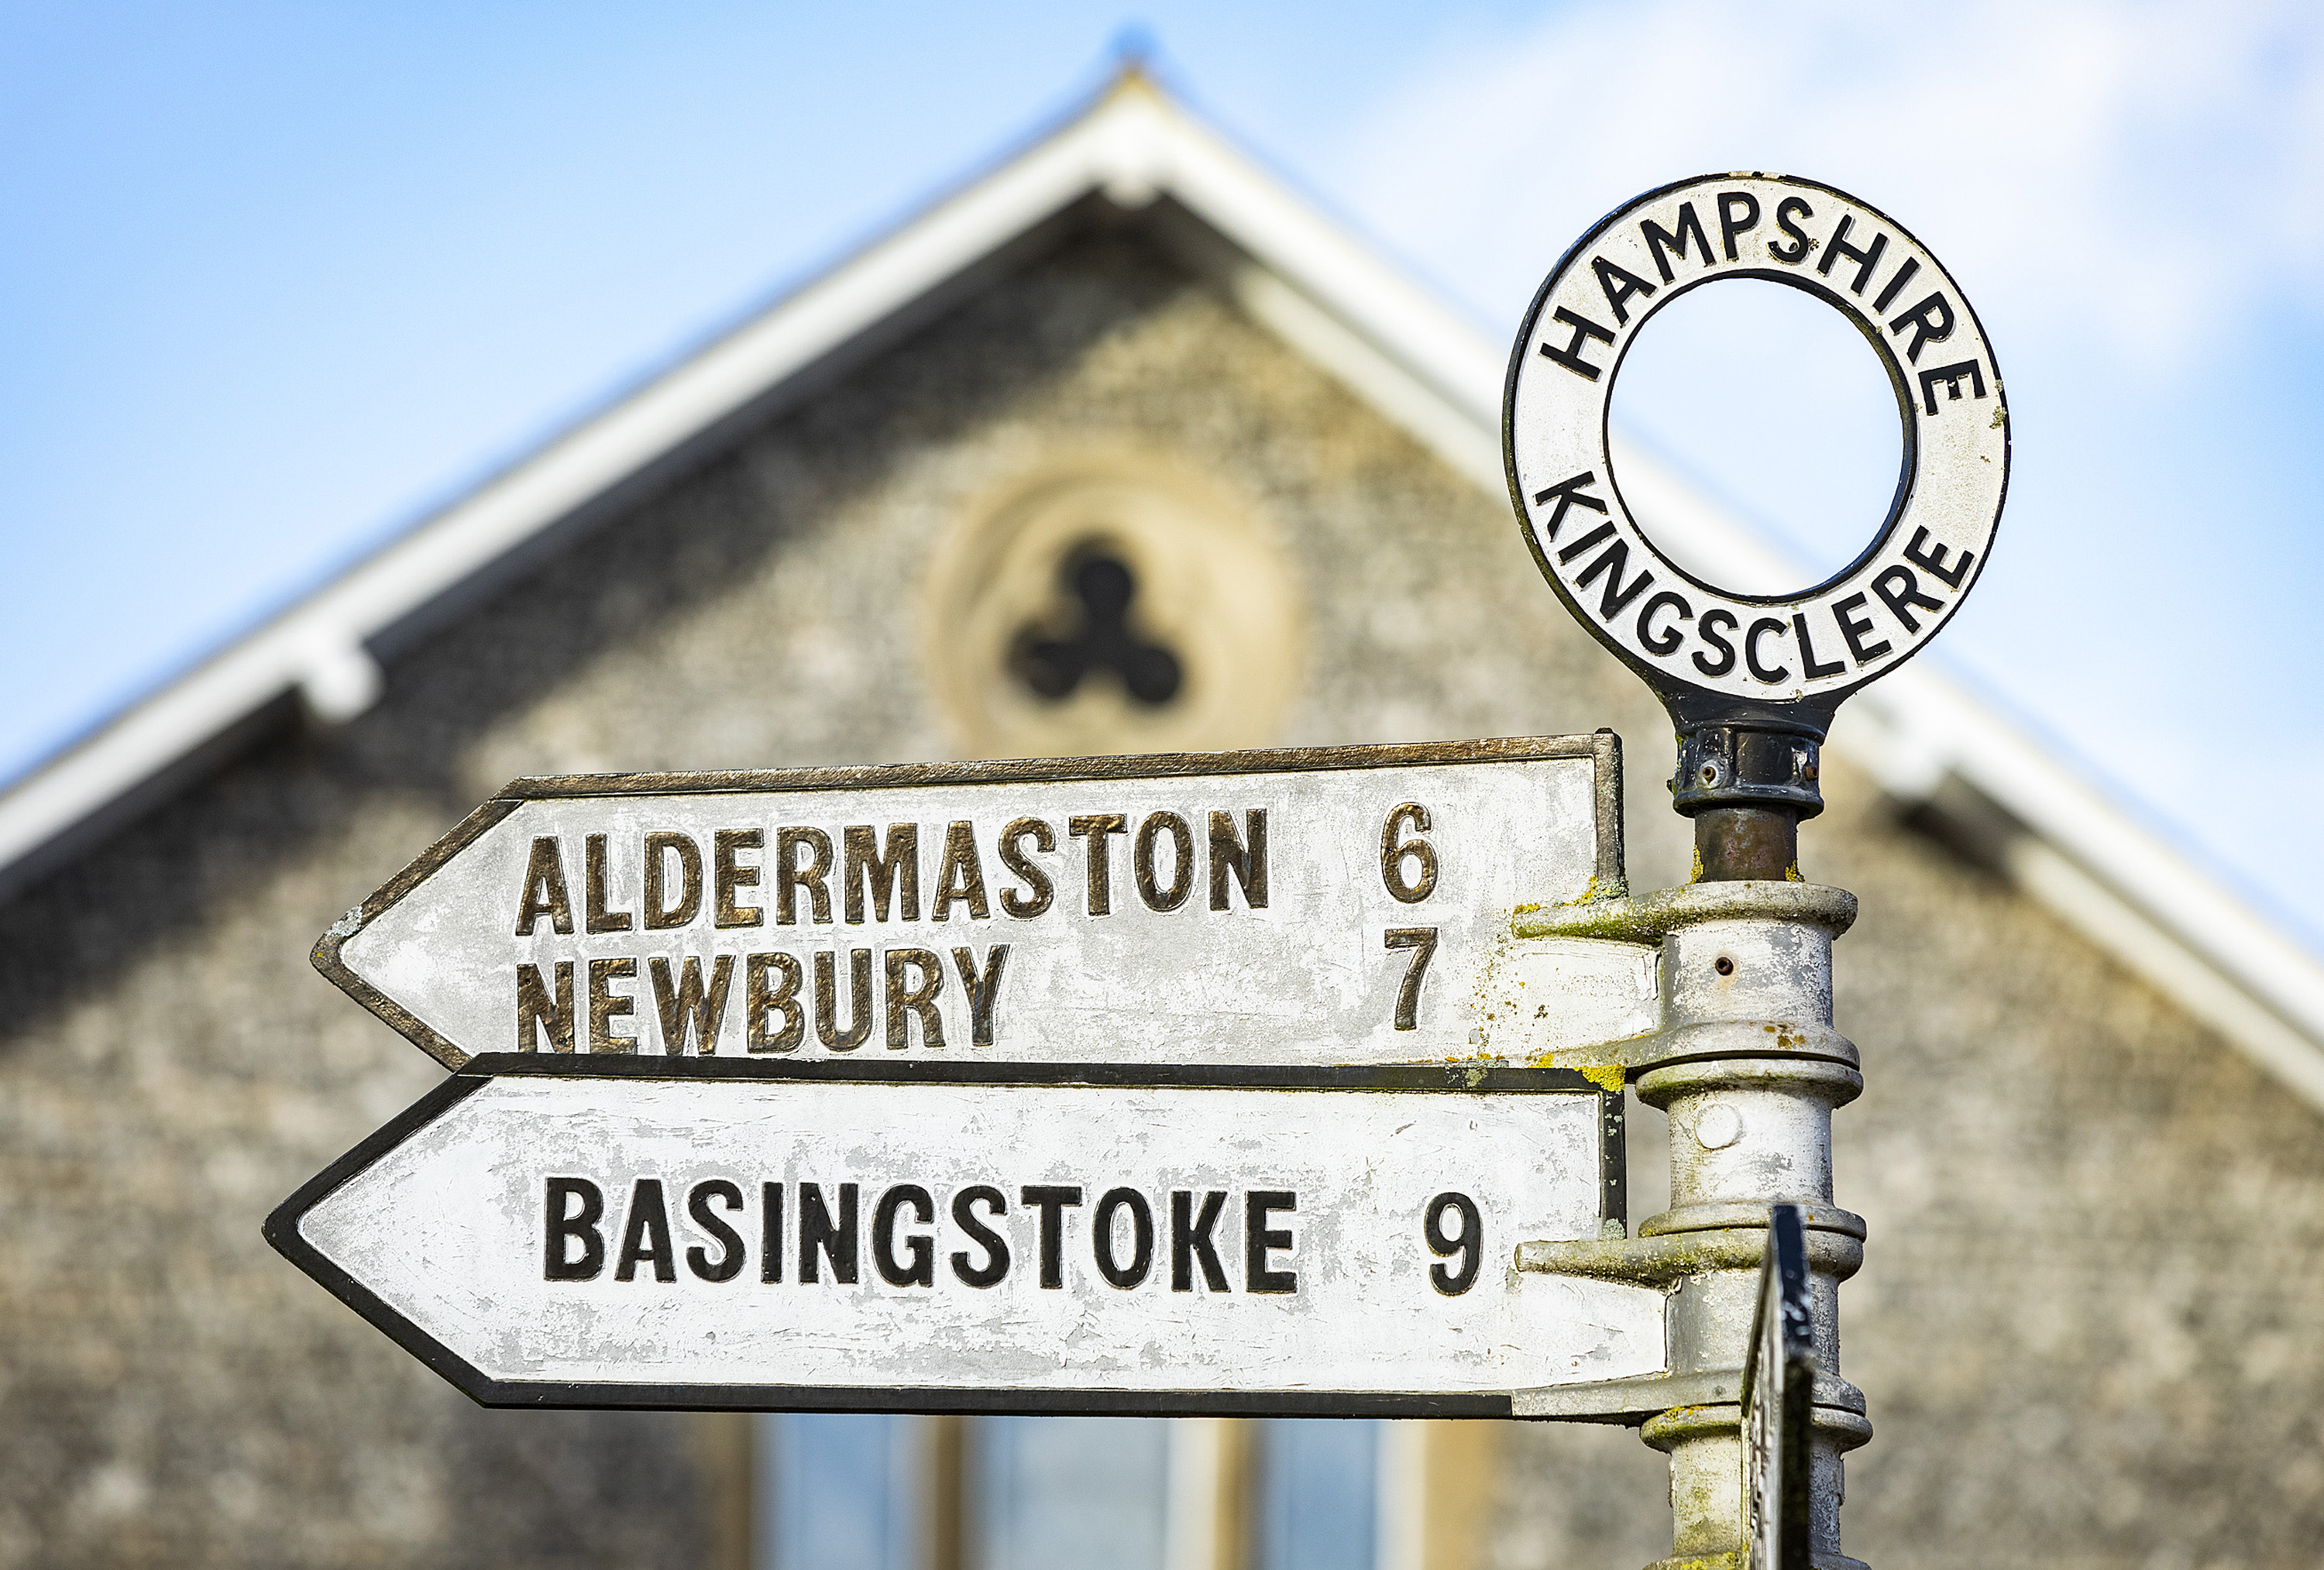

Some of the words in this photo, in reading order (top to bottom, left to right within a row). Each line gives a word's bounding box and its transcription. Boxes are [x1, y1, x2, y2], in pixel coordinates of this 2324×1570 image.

[1538, 191, 1987, 416] HAMPSHIRE
[1535, 470, 1975, 684] KINGSCLERE
[515, 808, 1268, 936] ALDERMASTON
[1380, 801, 1439, 903] 6
[517, 942, 1010, 1055] NEWBURY
[1384, 926, 1439, 1031] 7
[544, 1177, 1298, 1293] BASINGSTOKE
[1423, 1190, 1483, 1297] 9
